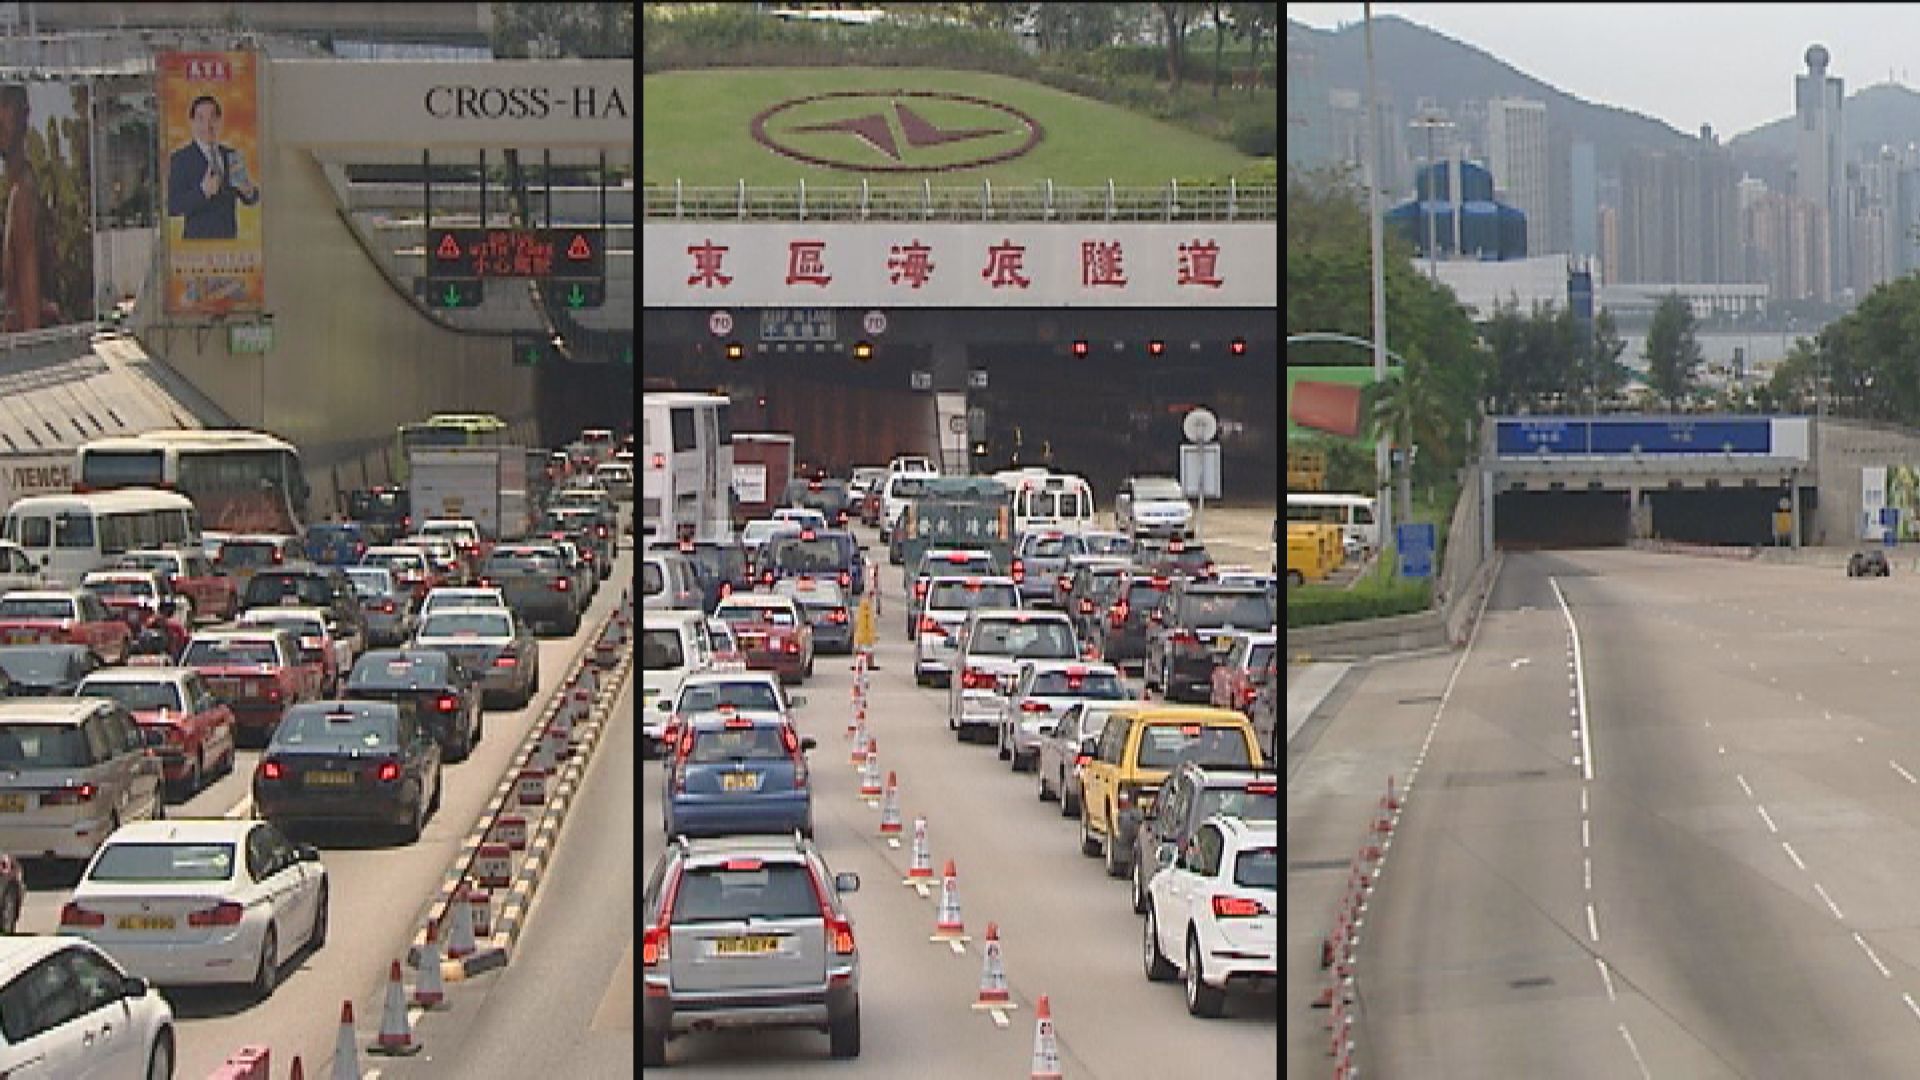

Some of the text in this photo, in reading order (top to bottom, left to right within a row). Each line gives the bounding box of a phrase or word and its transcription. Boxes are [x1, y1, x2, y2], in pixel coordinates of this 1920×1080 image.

[424, 85, 629, 119] CROSS-HA
[686, 238, 1225, 289] 東區海底隧道
